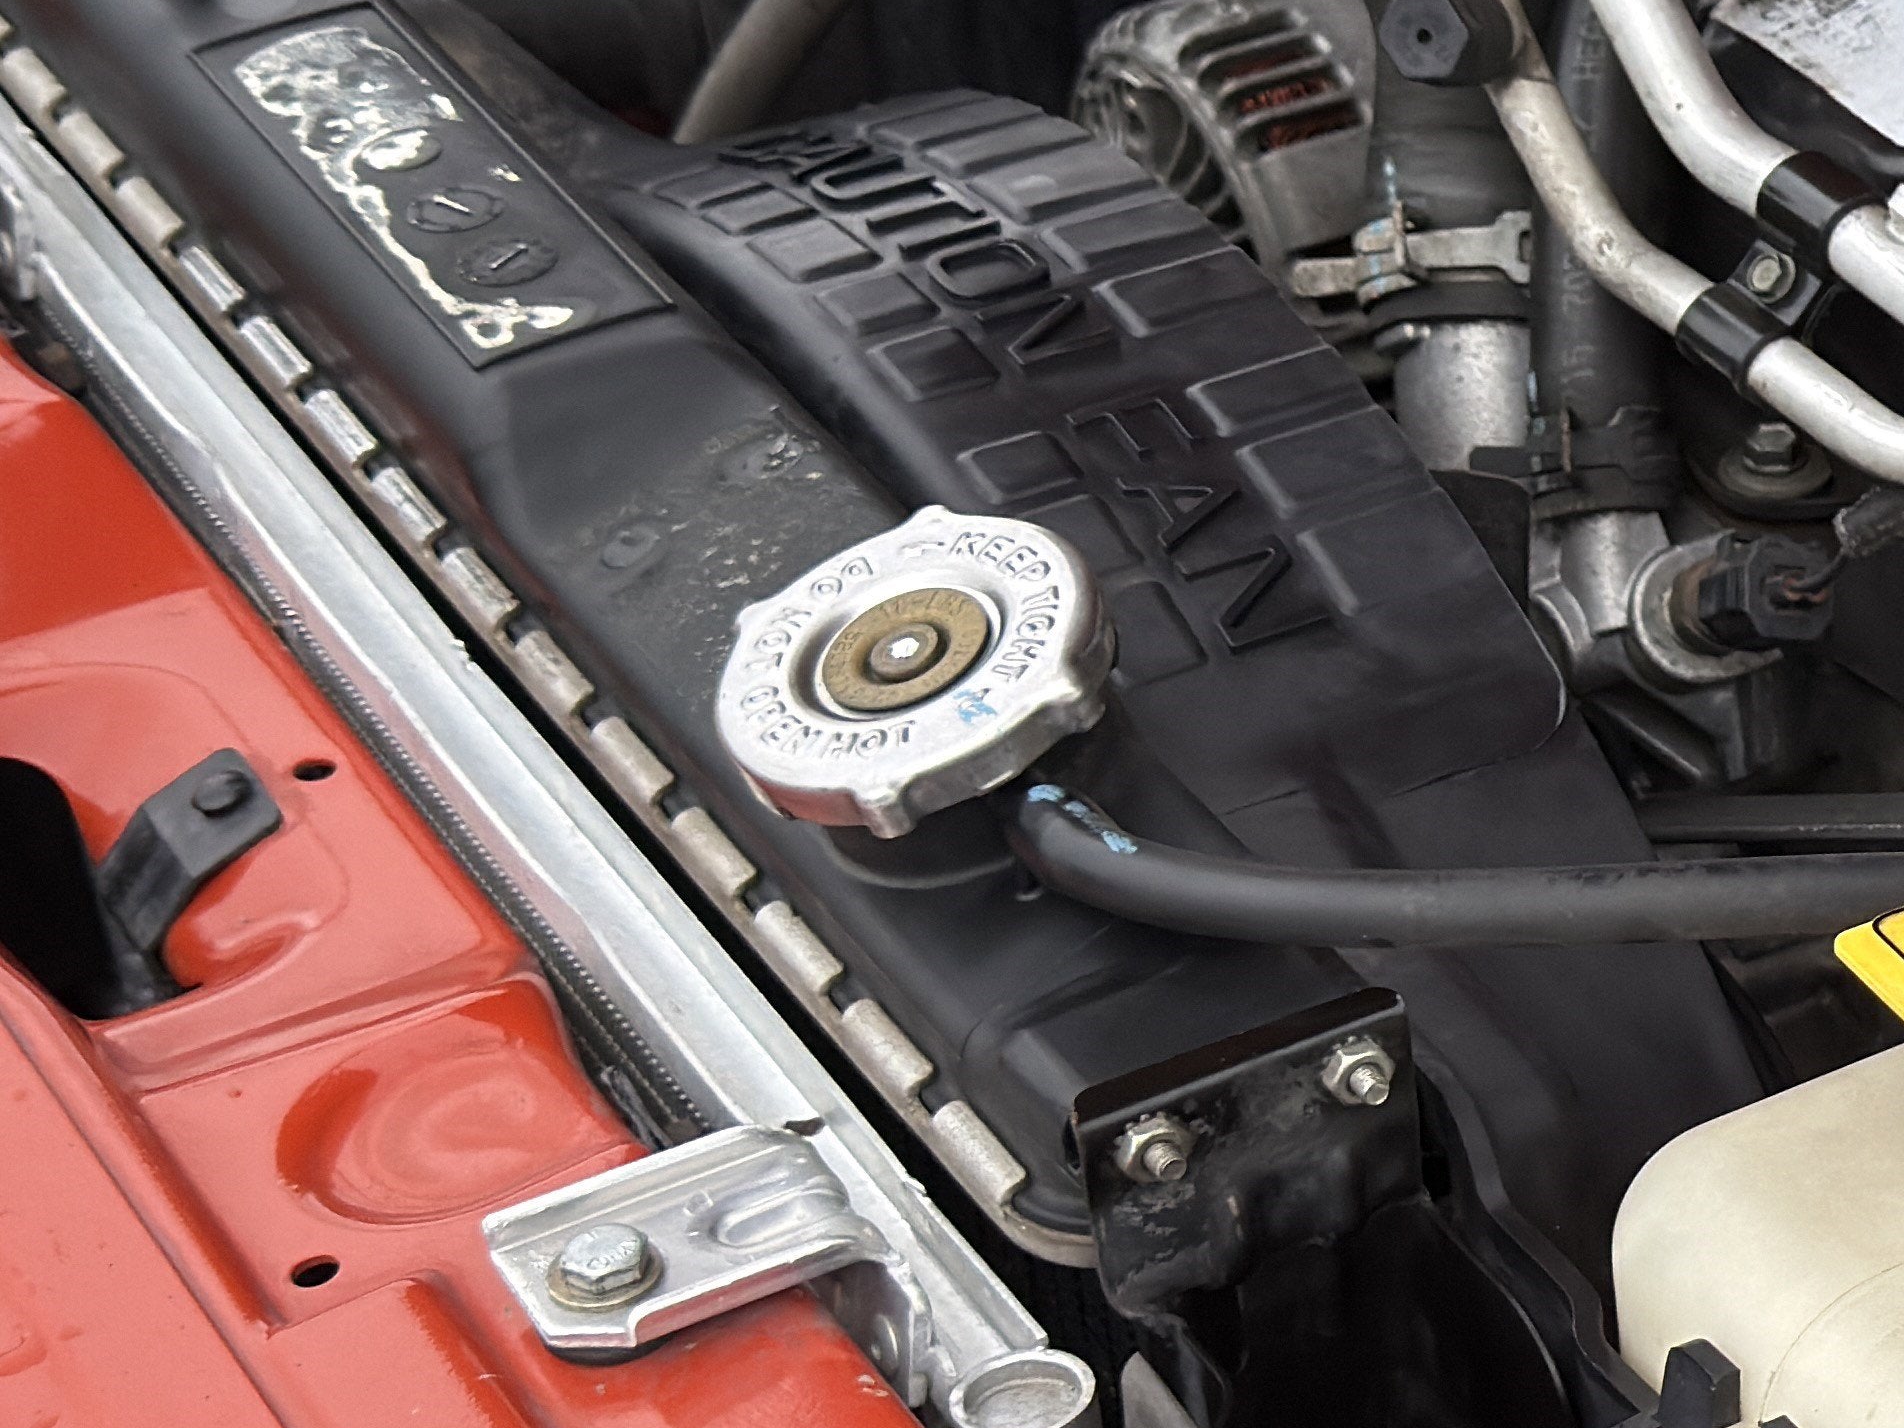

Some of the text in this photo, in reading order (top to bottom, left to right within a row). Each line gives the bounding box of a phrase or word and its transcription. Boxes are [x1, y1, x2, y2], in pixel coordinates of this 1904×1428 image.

[1064, 398, 1331, 651] FAN
[810, 555, 875, 600] DO
[949, 530, 1061, 684] KEEP TIGHT
[740, 684, 824, 759] OPEN
[820, 718, 917, 760] HOT
